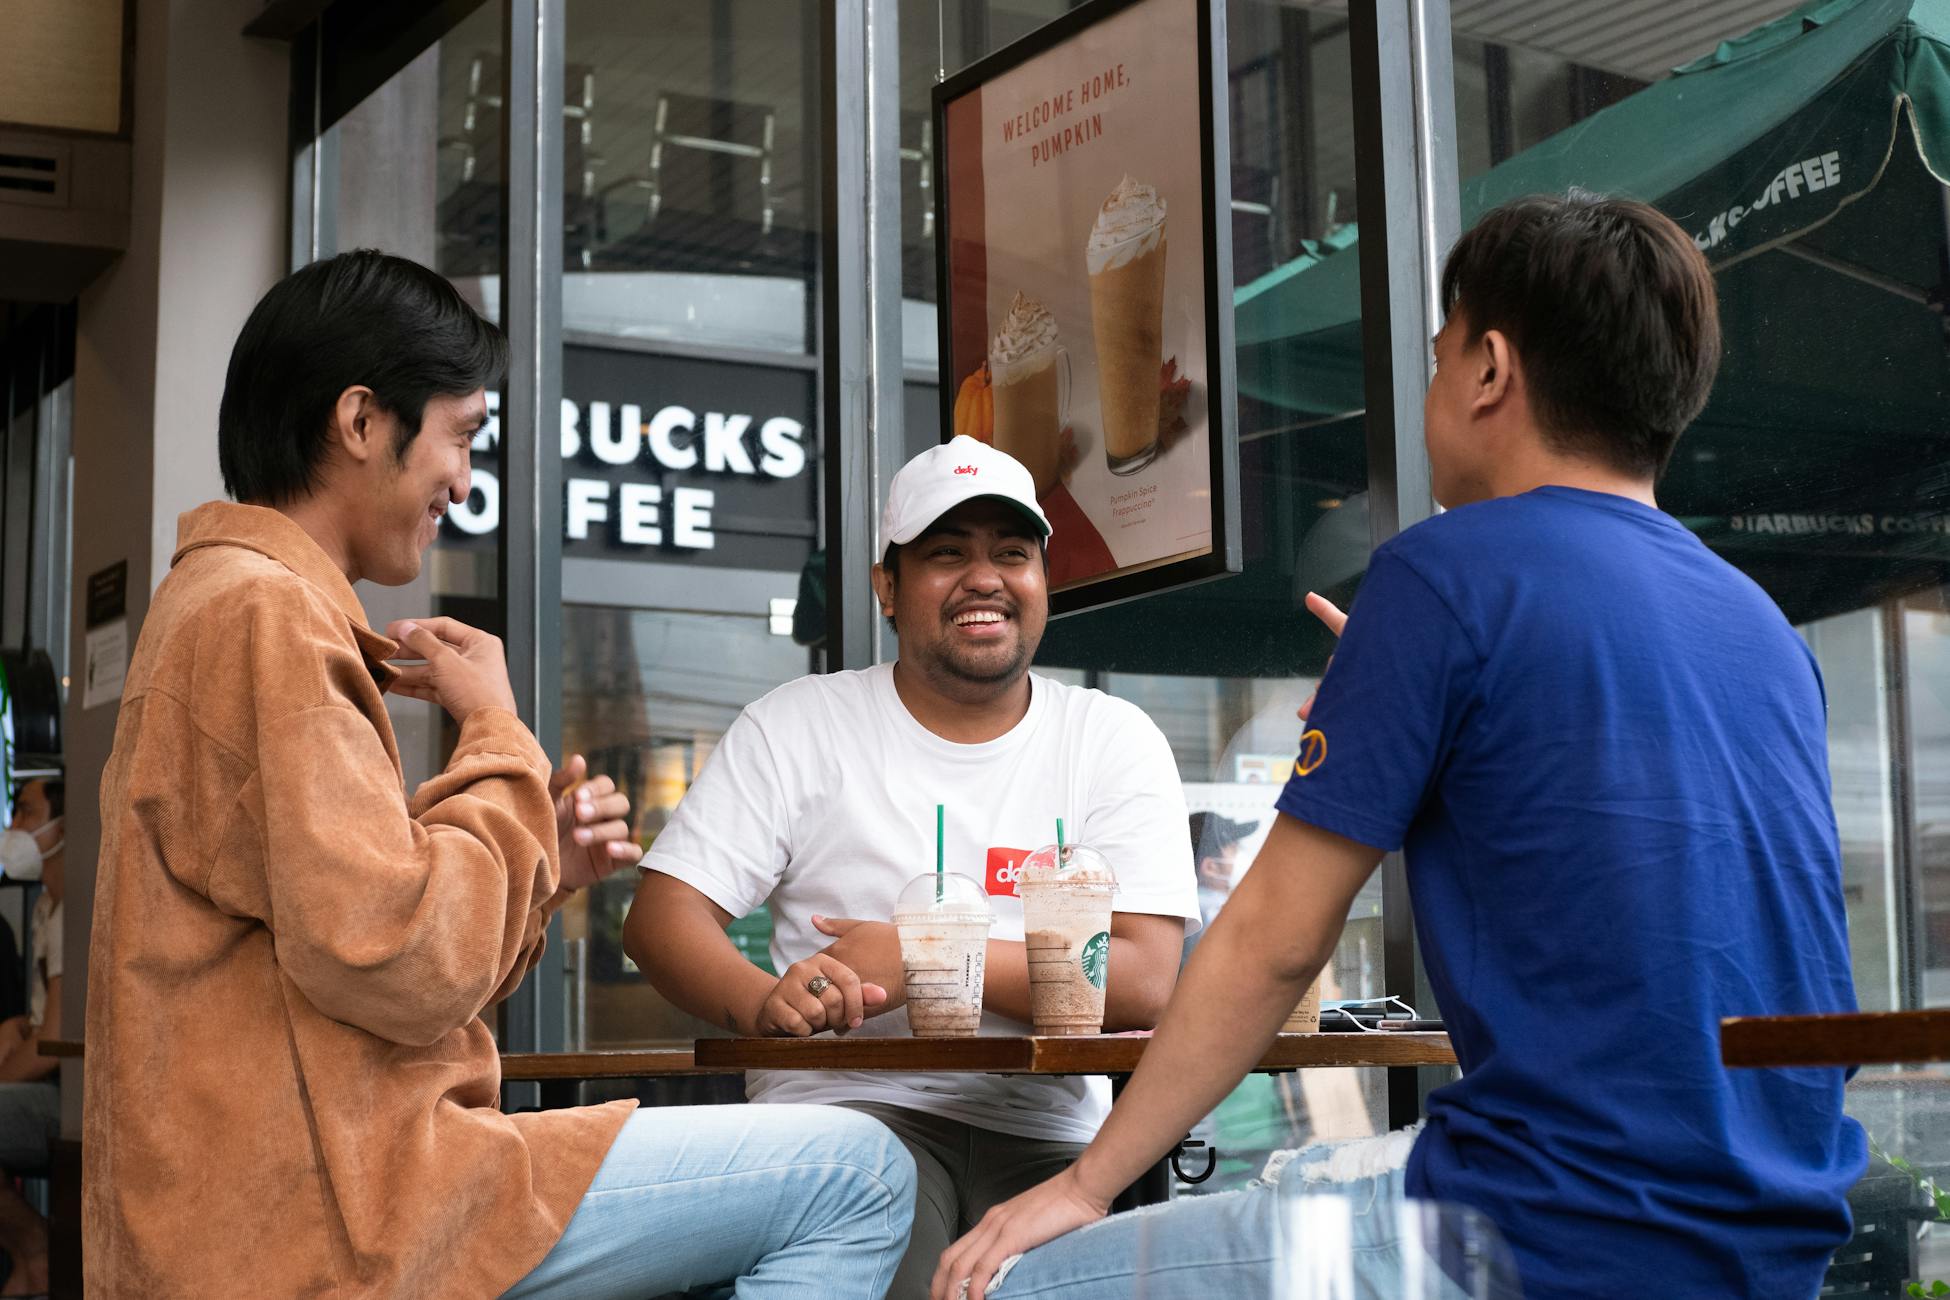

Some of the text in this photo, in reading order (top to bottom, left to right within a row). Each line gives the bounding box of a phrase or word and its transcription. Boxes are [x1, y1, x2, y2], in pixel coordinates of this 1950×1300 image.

[1002, 63, 1132, 143] WELCOME HOME,
[1031, 114, 1103, 167] PUMPKIN
[954, 465, 978, 476] defy
[1110, 484, 1158, 505] Pumpkin Spice
